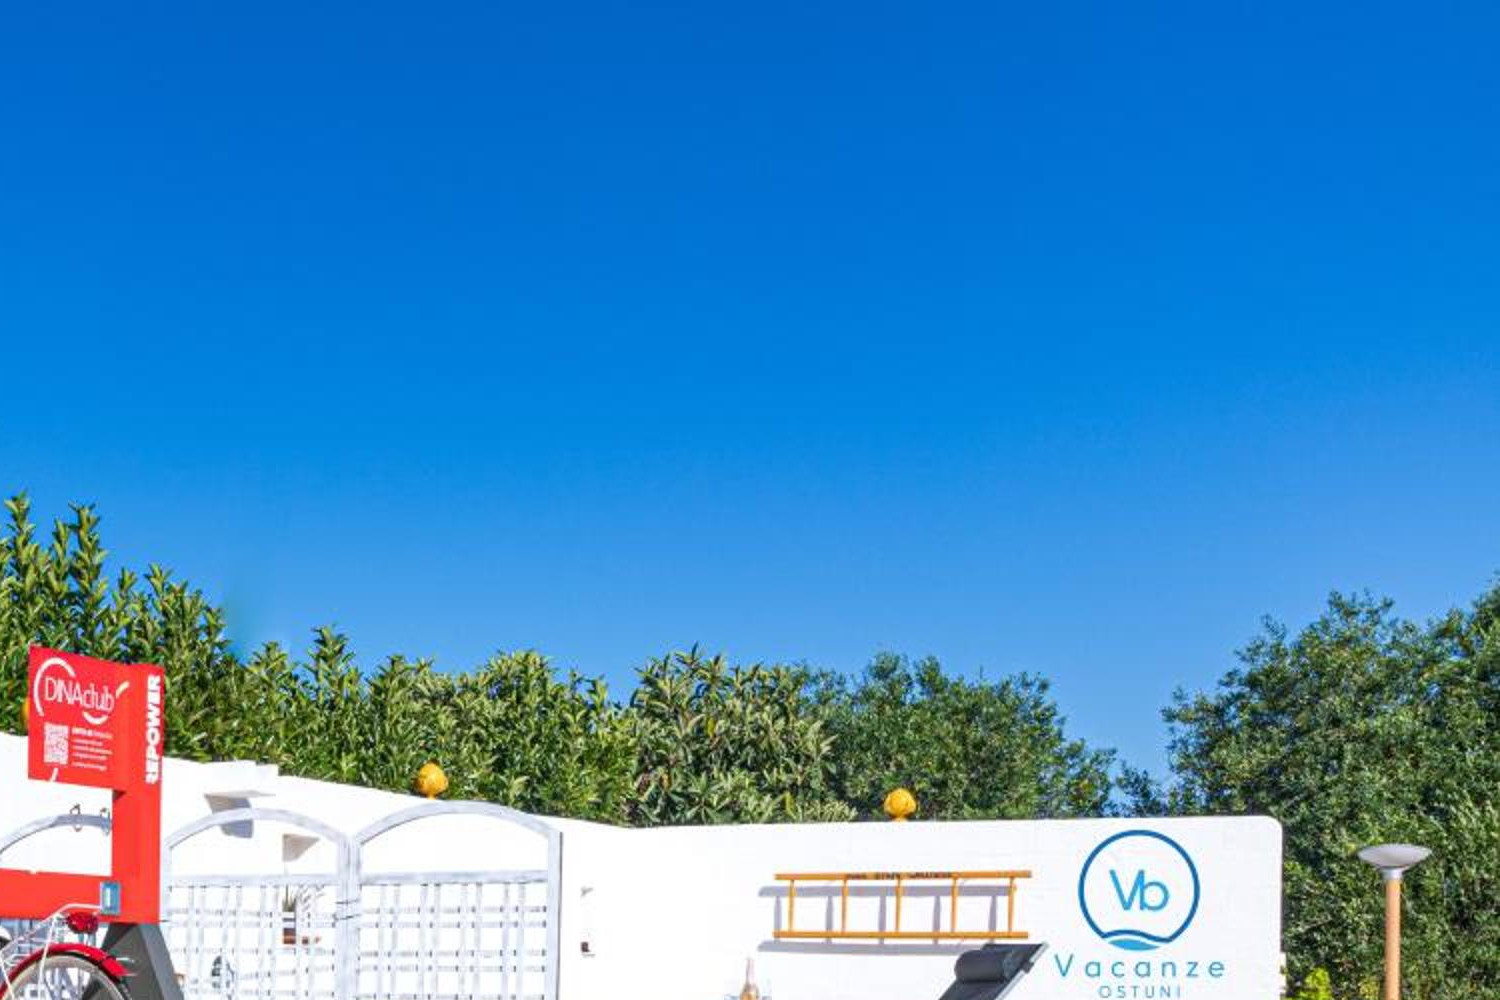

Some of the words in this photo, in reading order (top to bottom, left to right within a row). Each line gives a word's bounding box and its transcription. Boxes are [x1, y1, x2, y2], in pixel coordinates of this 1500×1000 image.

[1109, 869, 1170, 911] Vb
[1054, 953, 1226, 979] Vacanze
[1099, 985, 1181, 999] OSTUNI
